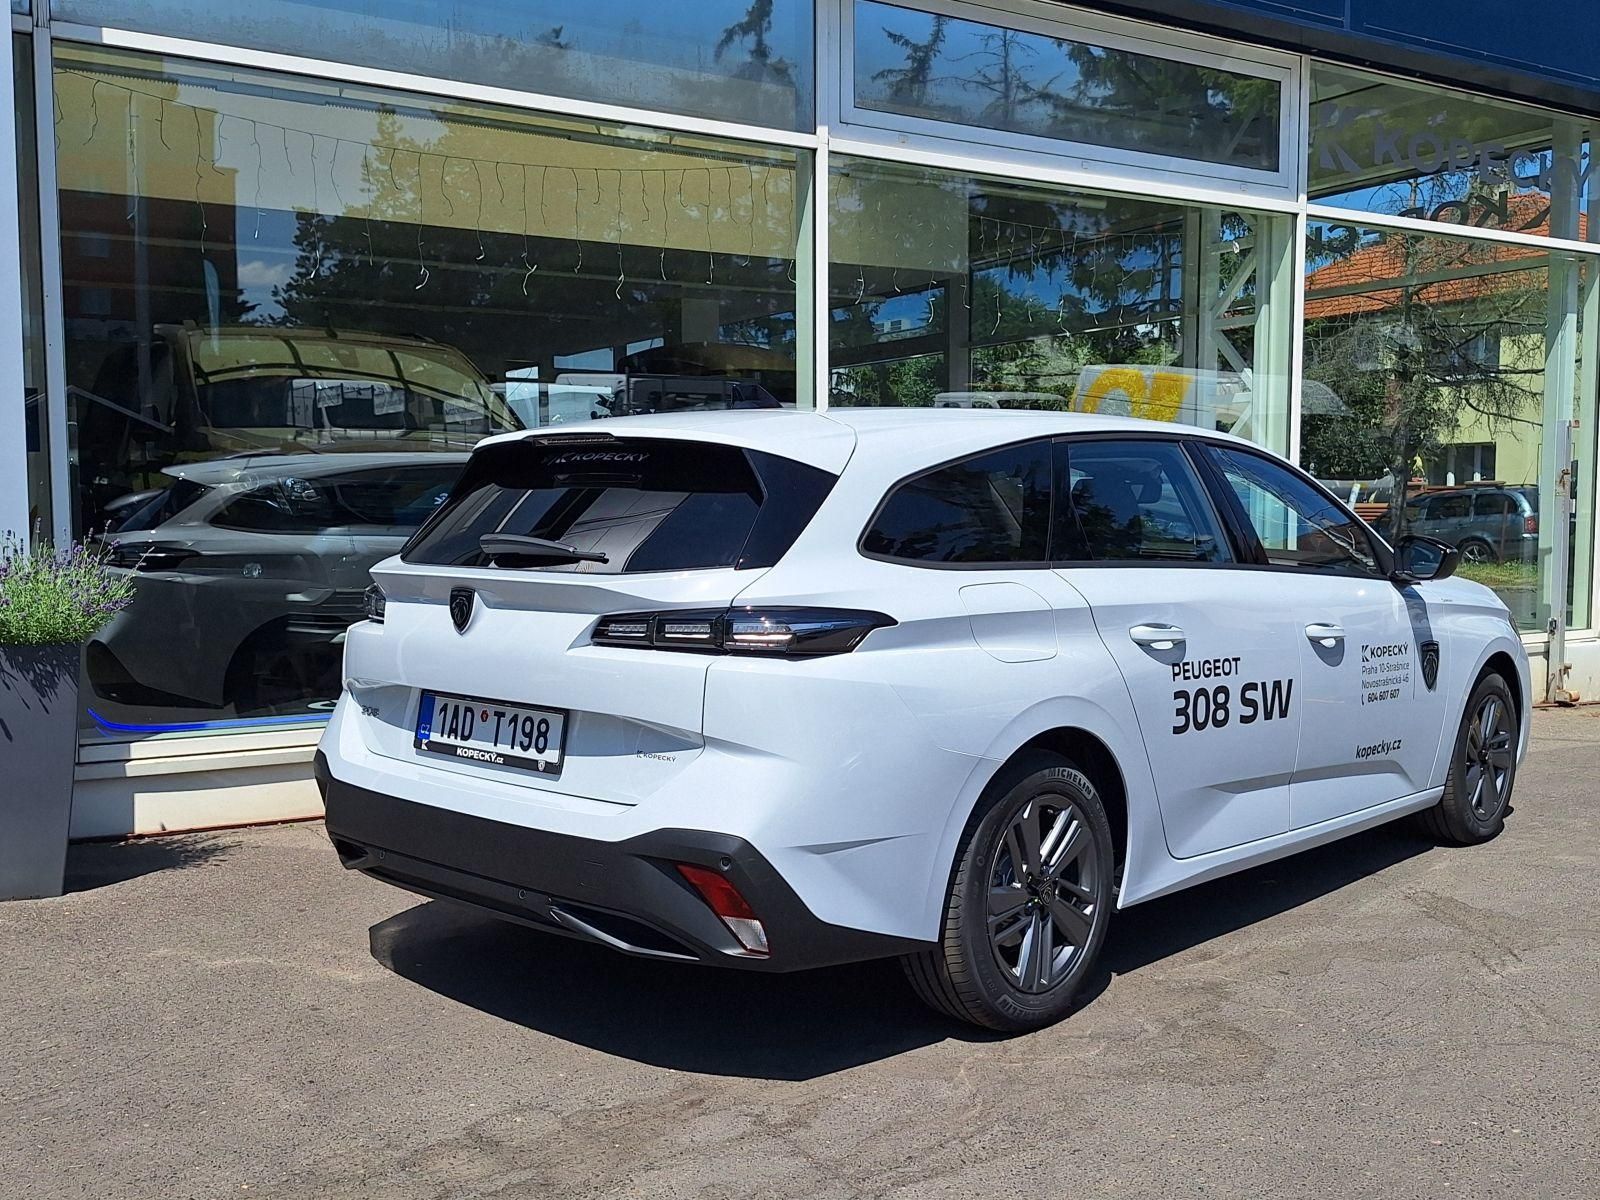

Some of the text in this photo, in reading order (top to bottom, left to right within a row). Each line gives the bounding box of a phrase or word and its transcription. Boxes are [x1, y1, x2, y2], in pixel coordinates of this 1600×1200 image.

[1370, 641, 1408, 658] KOPECKÝ
[1172, 657, 1241, 682] PEUGEOT
[1361, 665, 1378, 675] Praha
[1402, 673, 1410, 683] 46
[1172, 678, 1293, 735] 308 SW
[1367, 688, 1400, 703] 604 607 607
[420, 702, 550, 755] CZ 1AD T198
[1355, 738, 1402, 760] kopecky.cz
[1047, 767, 1093, 796] MICHELIN
